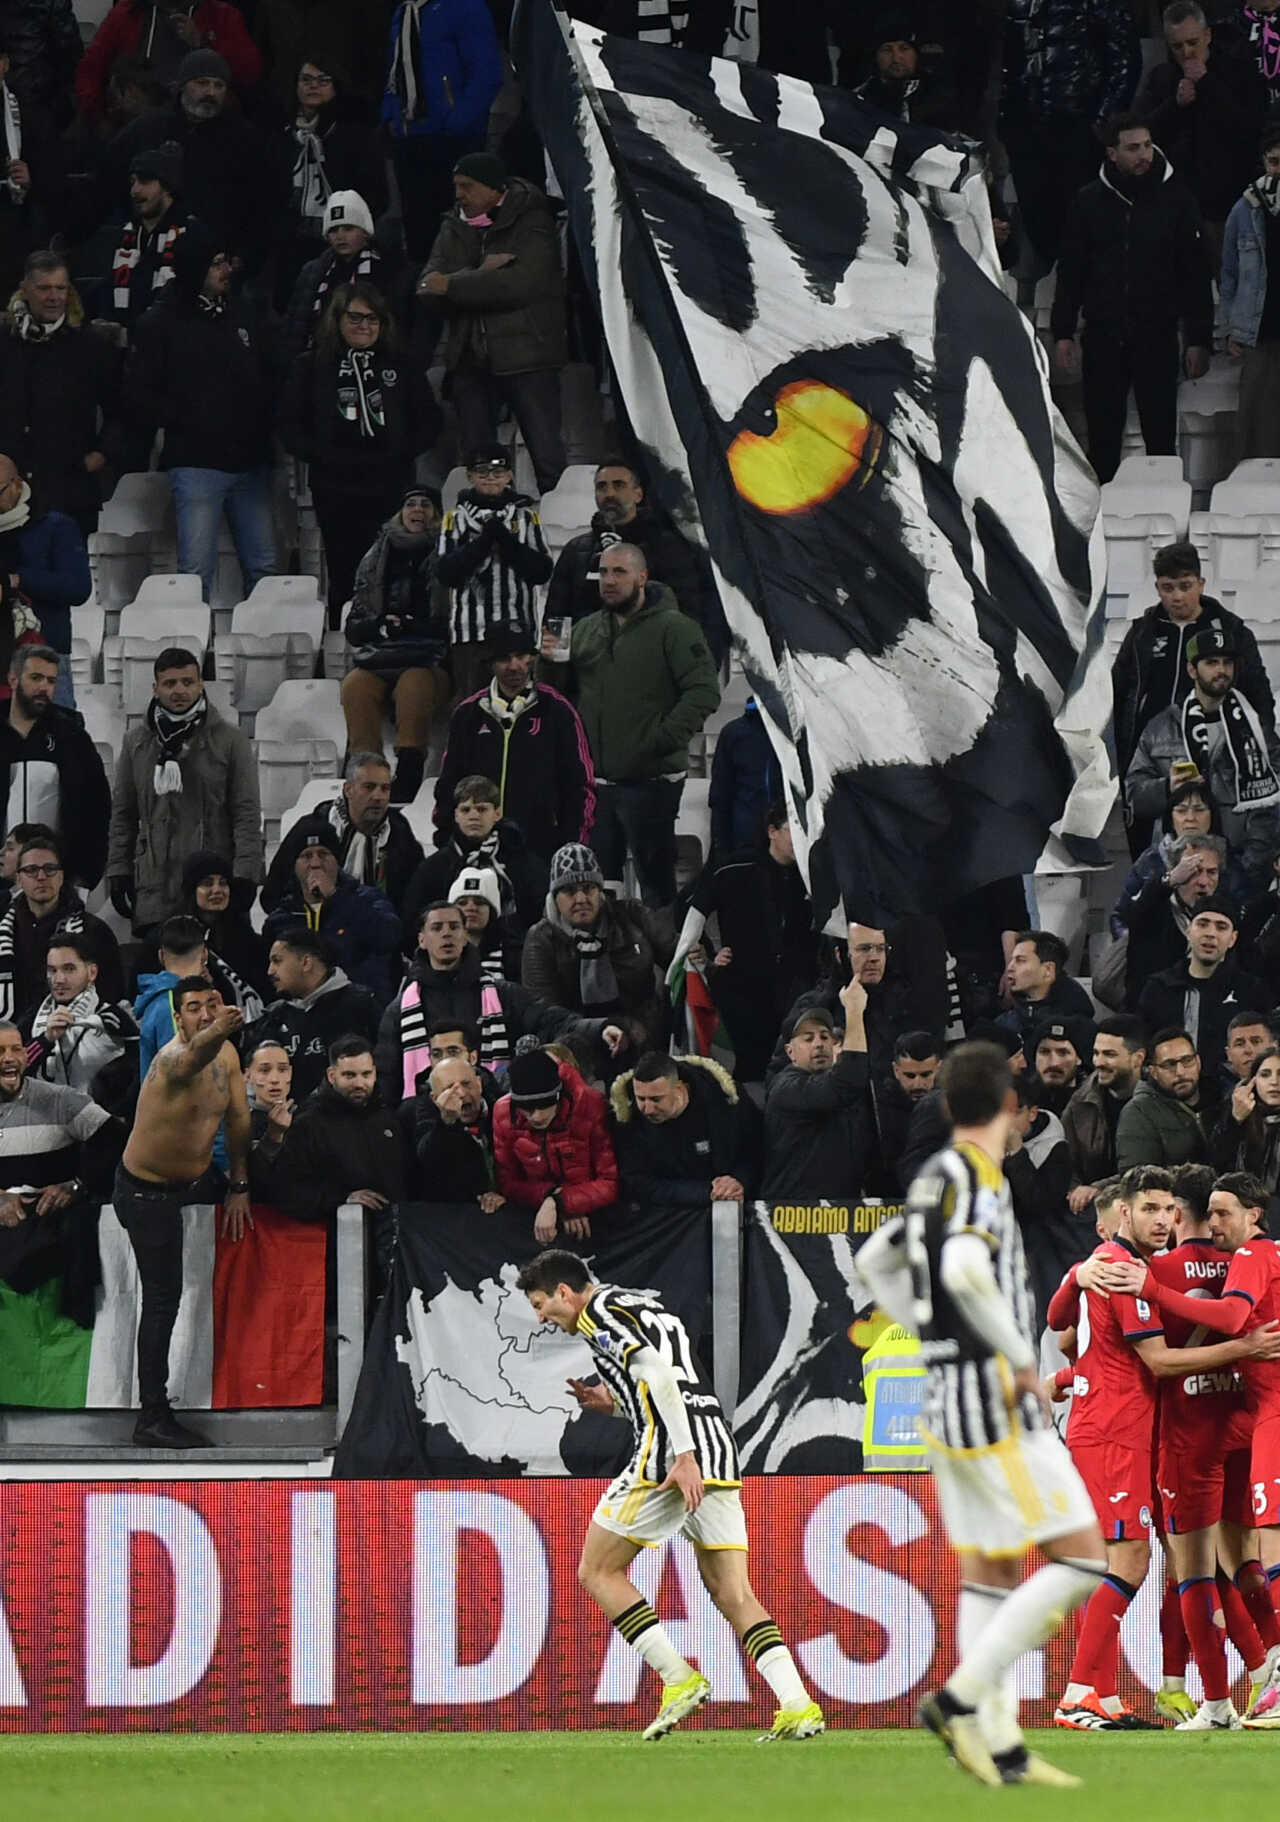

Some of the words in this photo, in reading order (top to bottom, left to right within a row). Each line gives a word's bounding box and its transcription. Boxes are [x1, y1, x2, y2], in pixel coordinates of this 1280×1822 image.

[773, 1205, 849, 1235] ABBIAMO
[853, 1205, 905, 1234] ANC
[1184, 1260, 1231, 1279] RUGG
